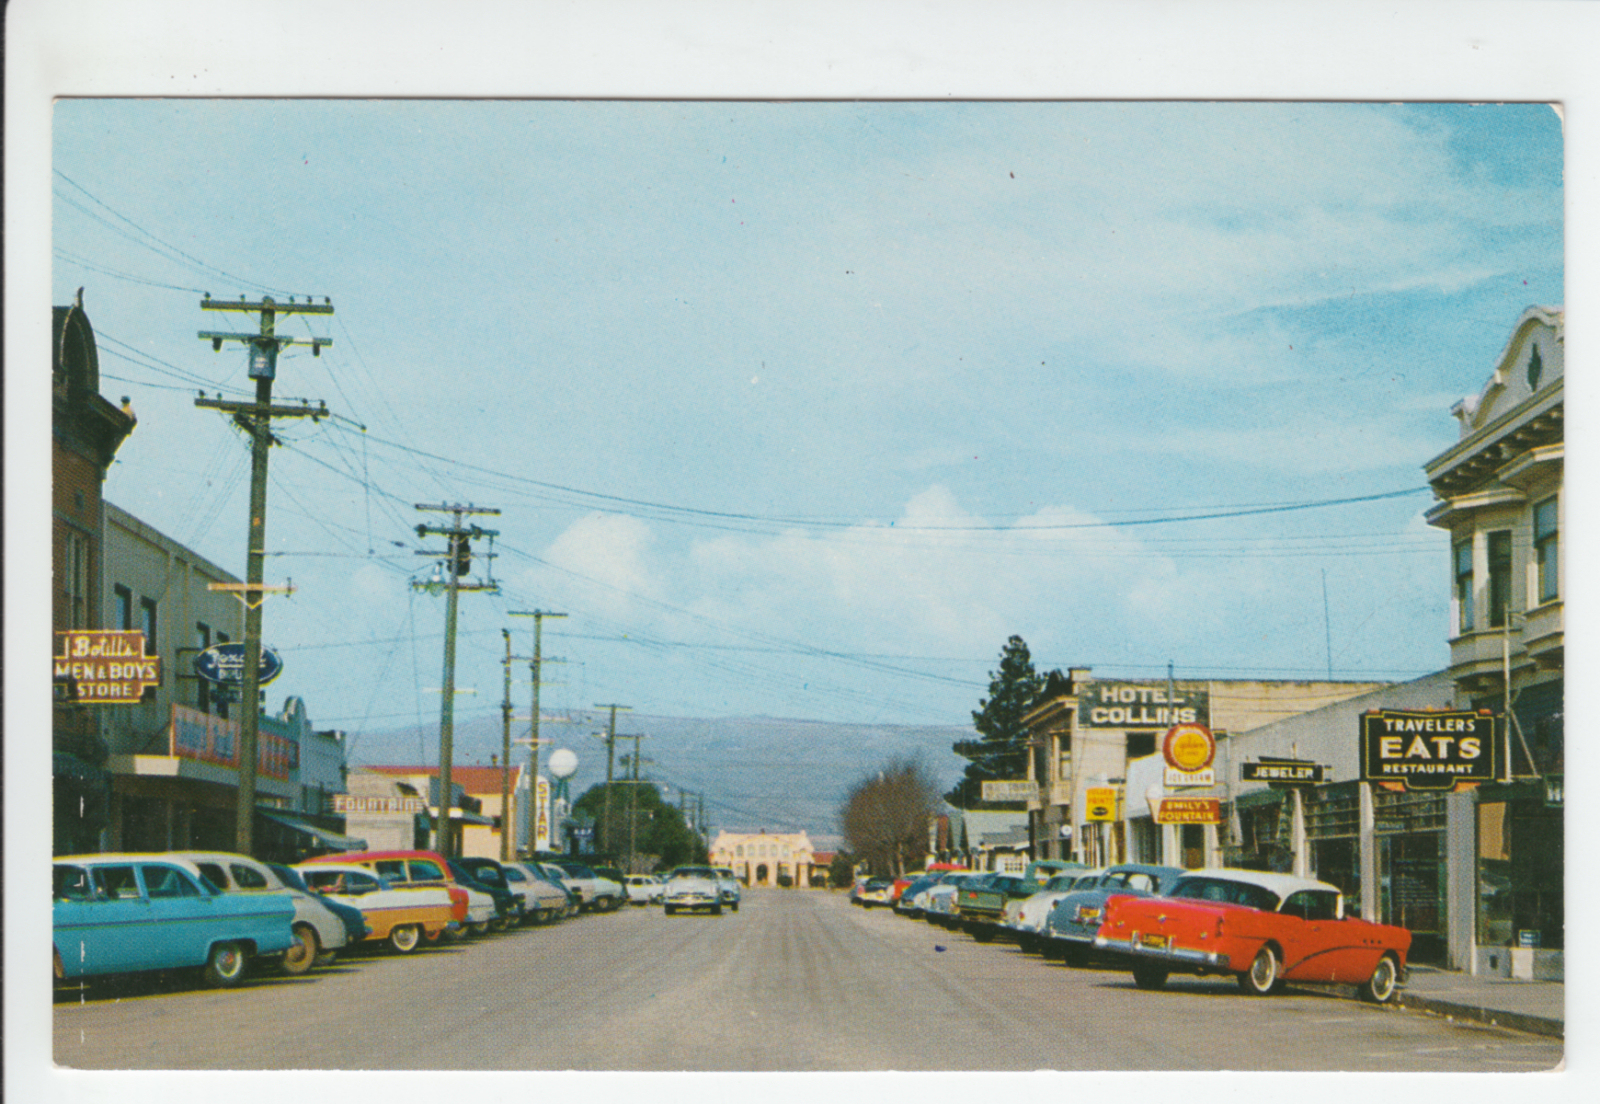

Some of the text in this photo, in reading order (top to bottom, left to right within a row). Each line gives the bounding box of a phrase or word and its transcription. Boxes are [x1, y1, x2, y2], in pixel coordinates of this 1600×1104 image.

[77, 682, 133, 697] STORE
[1091, 706, 1197, 724] COLLINS
[1383, 718, 1475, 732] TRAVELERS
[1380, 734, 1481, 759] EATS
[1251, 766, 1314, 779] JEWELER
[1383, 763, 1474, 774] RESTAURANT
[335, 796, 415, 813] FOUNTAIN
[537, 781, 548, 841] STAR
[1159, 811, 1215, 821] FOUNTAIN
